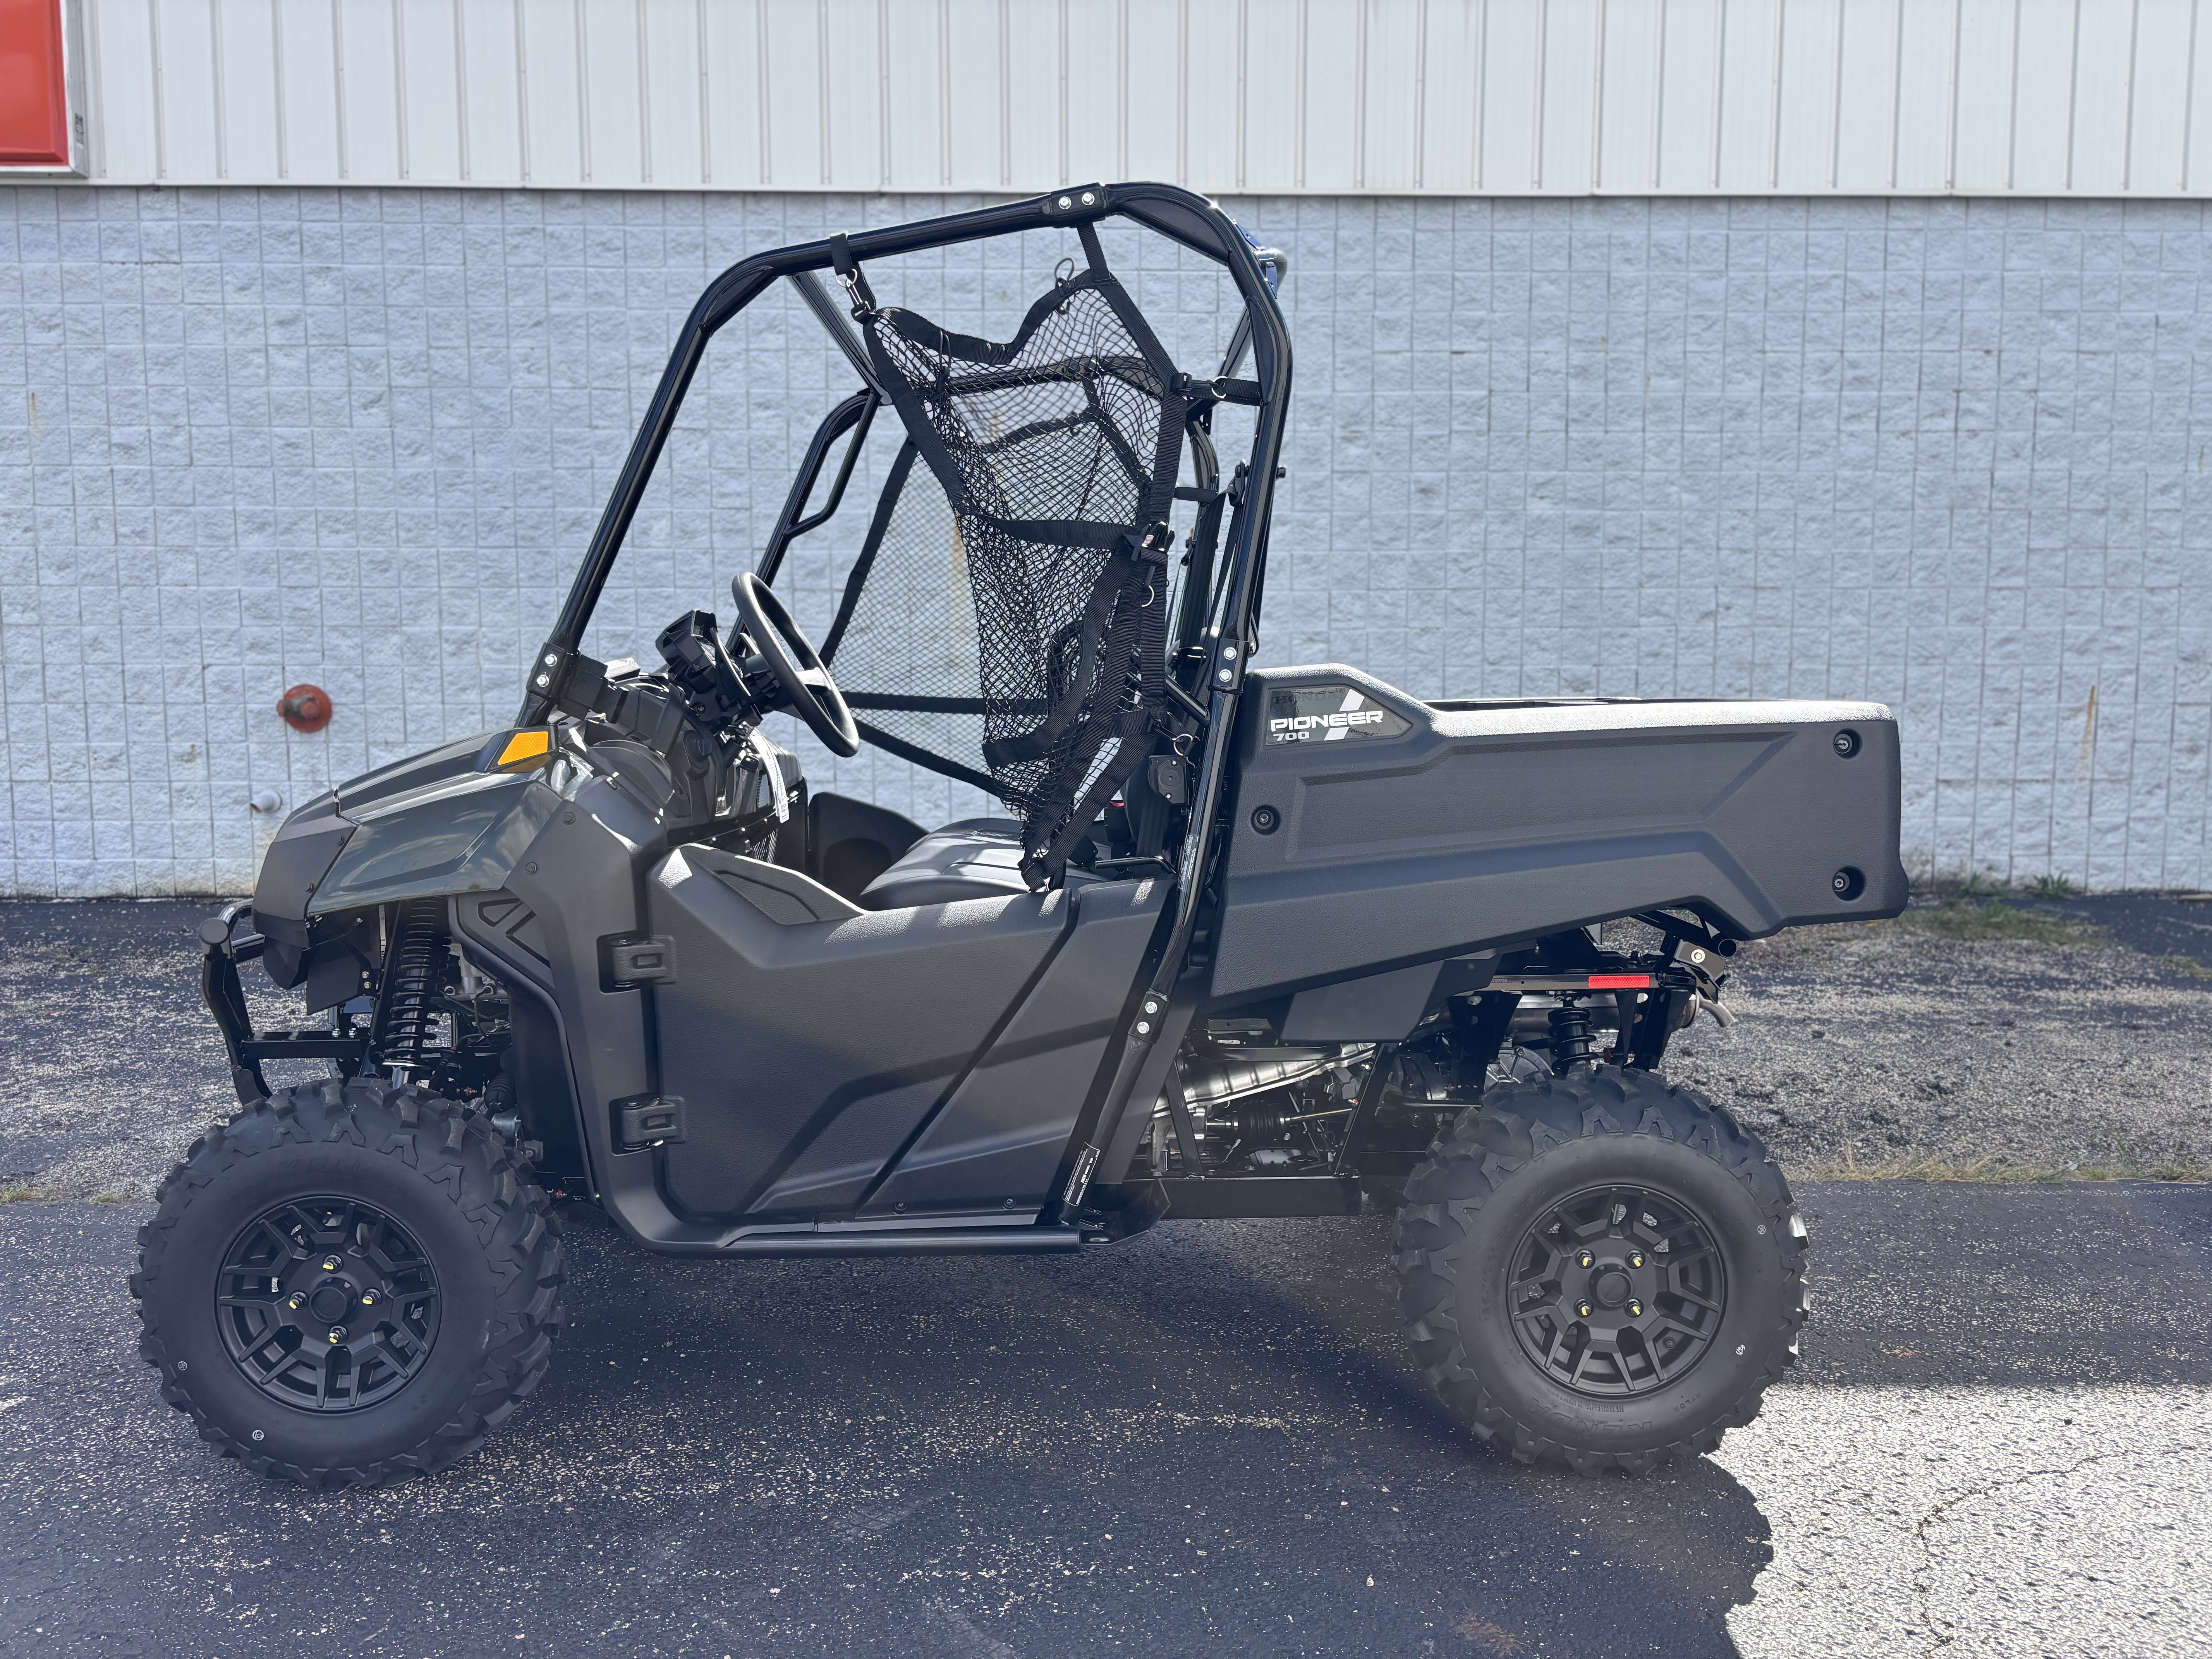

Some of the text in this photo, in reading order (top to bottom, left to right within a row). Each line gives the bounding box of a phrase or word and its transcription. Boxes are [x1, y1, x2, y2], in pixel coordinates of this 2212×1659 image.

[1271, 711, 1383, 732] PIONEER
[1273, 732, 1309, 741] 700
[1673, 1392, 1702, 1413] NYLON
[1527, 1397, 1652, 1442] KENDA
